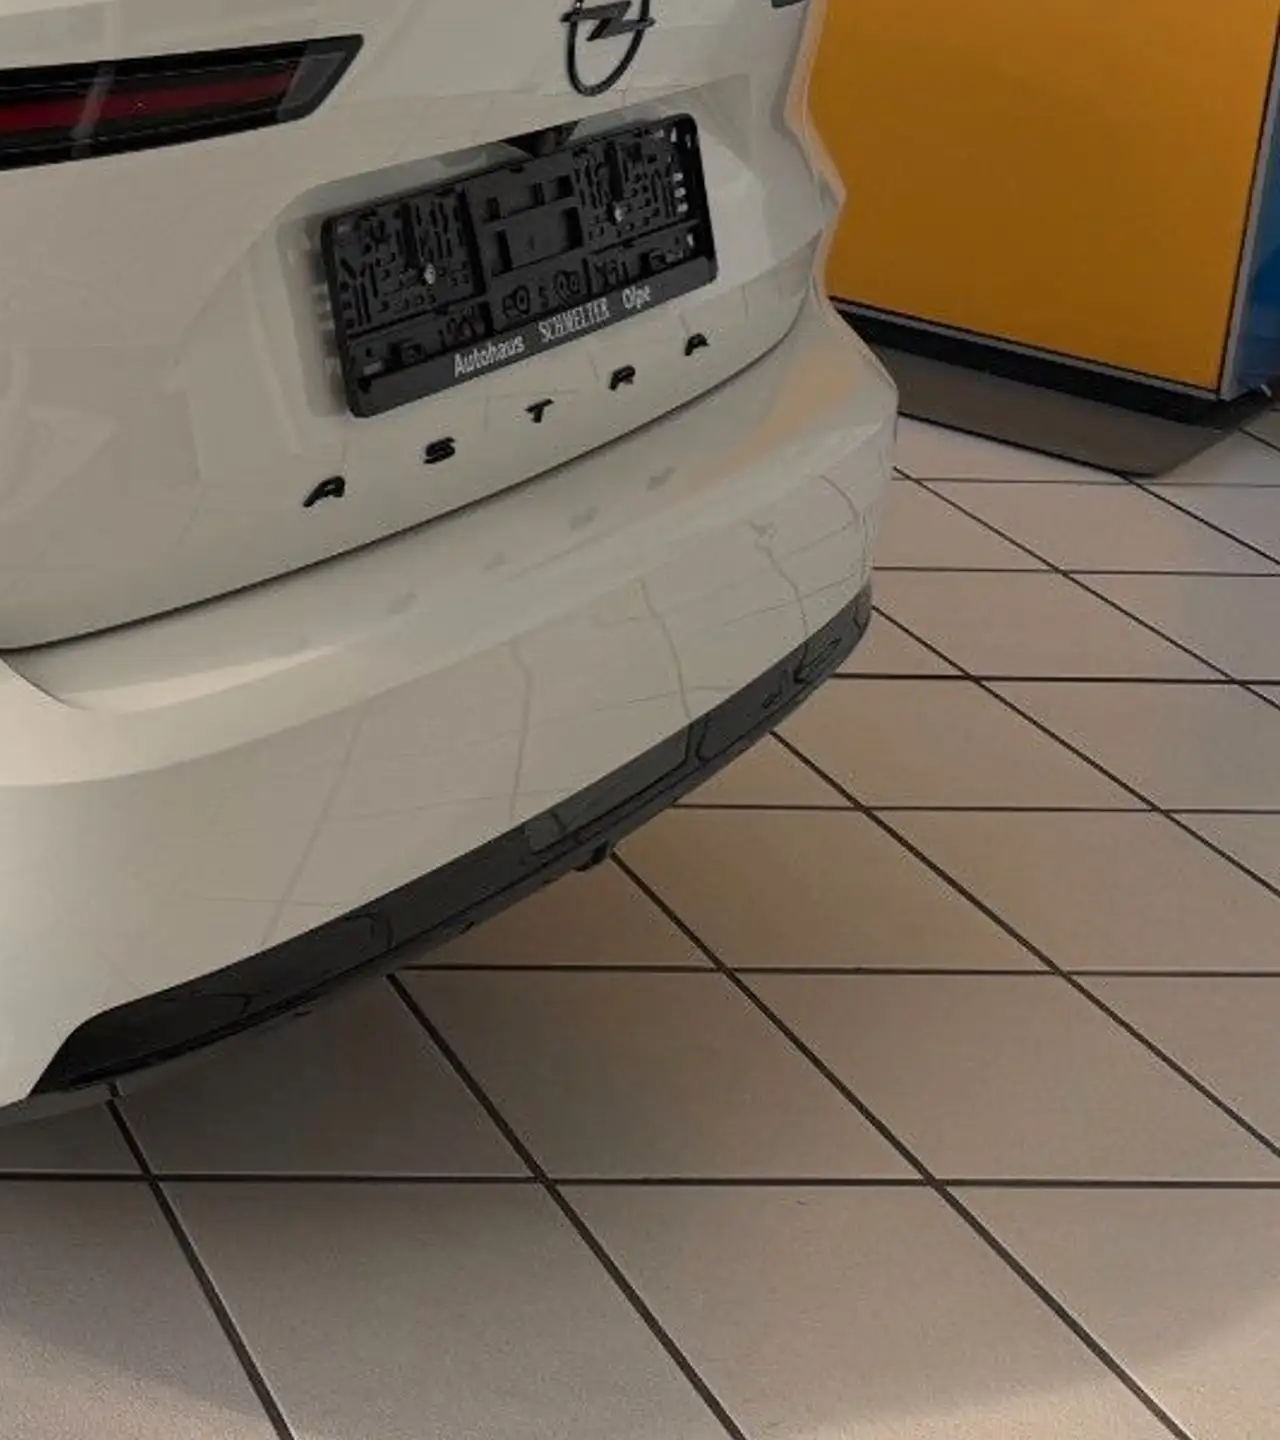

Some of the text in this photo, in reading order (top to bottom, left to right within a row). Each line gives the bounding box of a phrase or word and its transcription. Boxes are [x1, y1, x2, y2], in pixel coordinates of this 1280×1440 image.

[453, 335, 525, 378] Autohaus
[621, 284, 652, 311] Olpe
[302, 332, 711, 508] ASTRA
